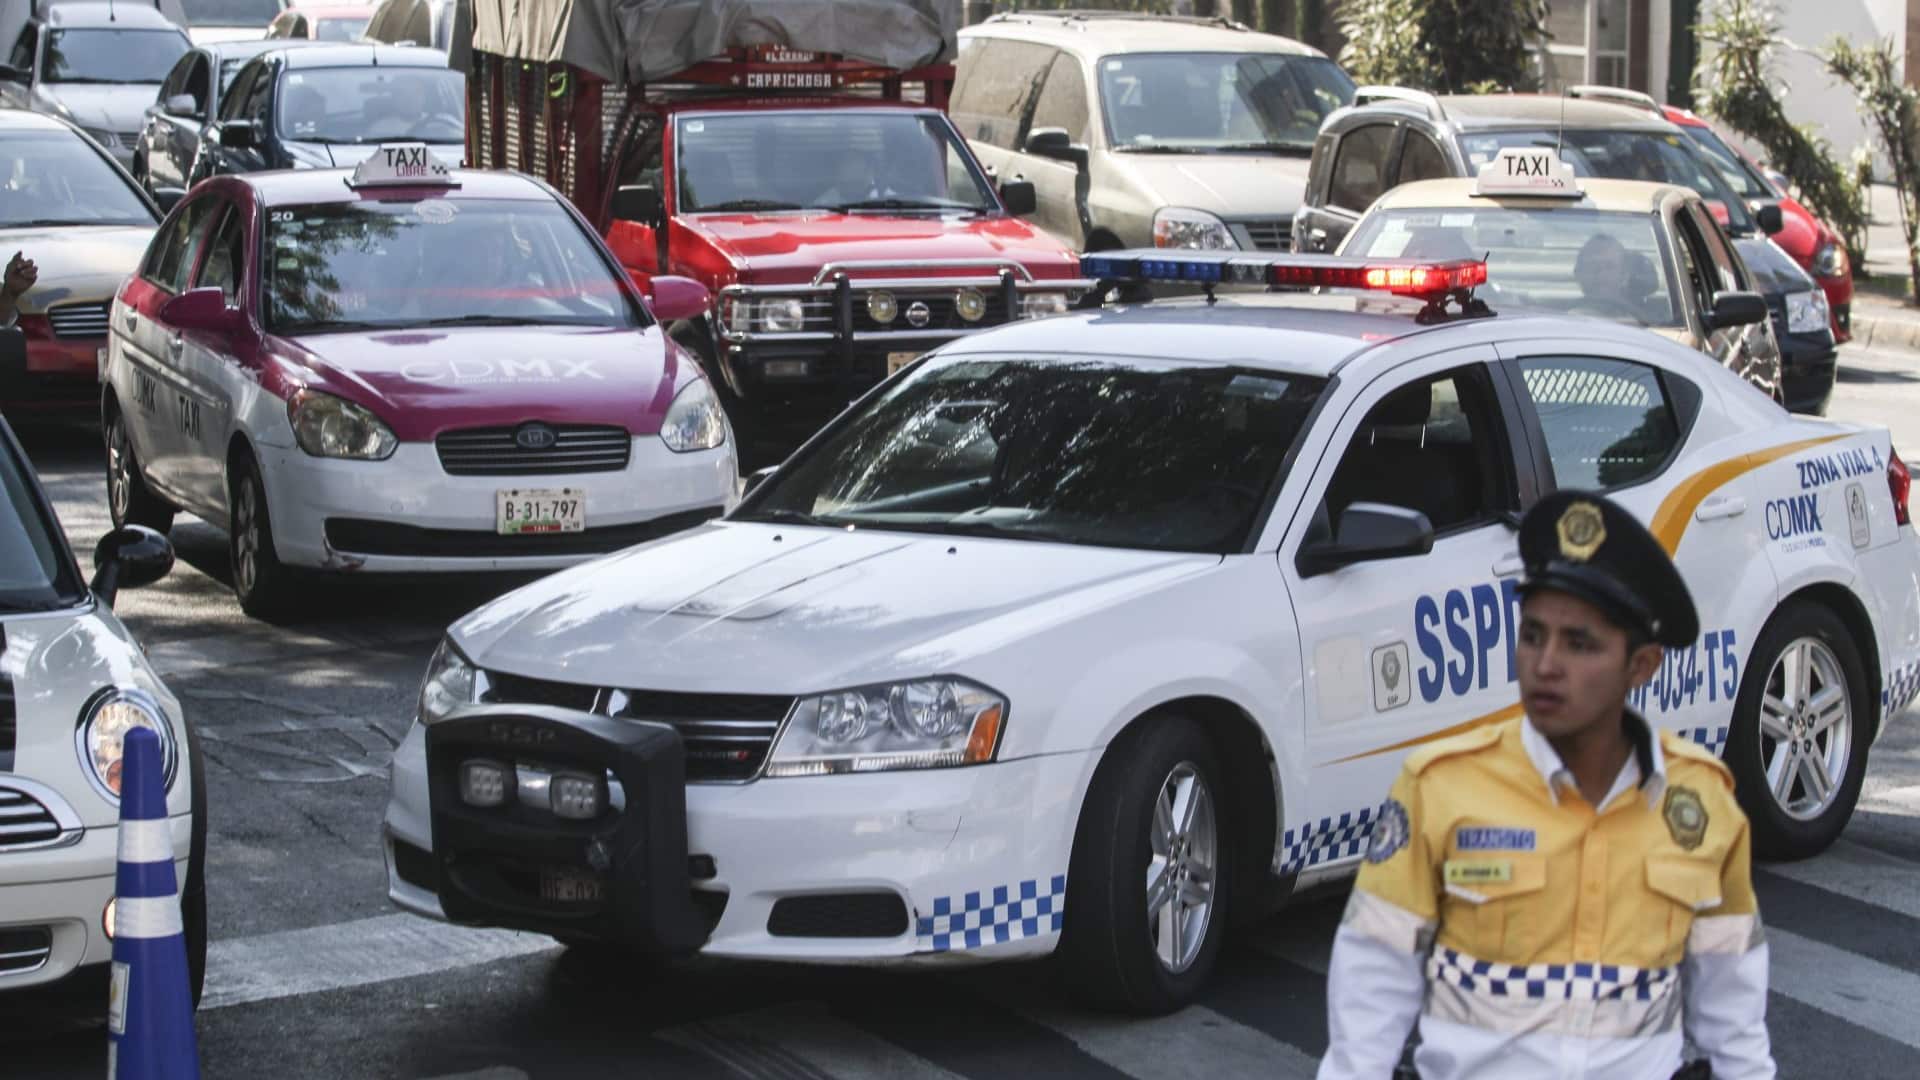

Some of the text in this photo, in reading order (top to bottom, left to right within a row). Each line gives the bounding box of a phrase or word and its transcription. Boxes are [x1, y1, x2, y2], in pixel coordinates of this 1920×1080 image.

[746, 73, 832, 88] CAPRICHOSA
[383, 147, 427, 168] TAXI
[1503, 156, 1550, 176] TAXI
[396, 166, 428, 176] LIBRE
[271, 211, 294, 222] 20
[400, 359, 605, 383] CDMX
[179, 395, 200, 440] TAXI
[1796, 444, 1884, 490] ZONA VIAL 4
[505, 500, 578, 521] B-31-797
[1765, 492, 1823, 541] CDMX
